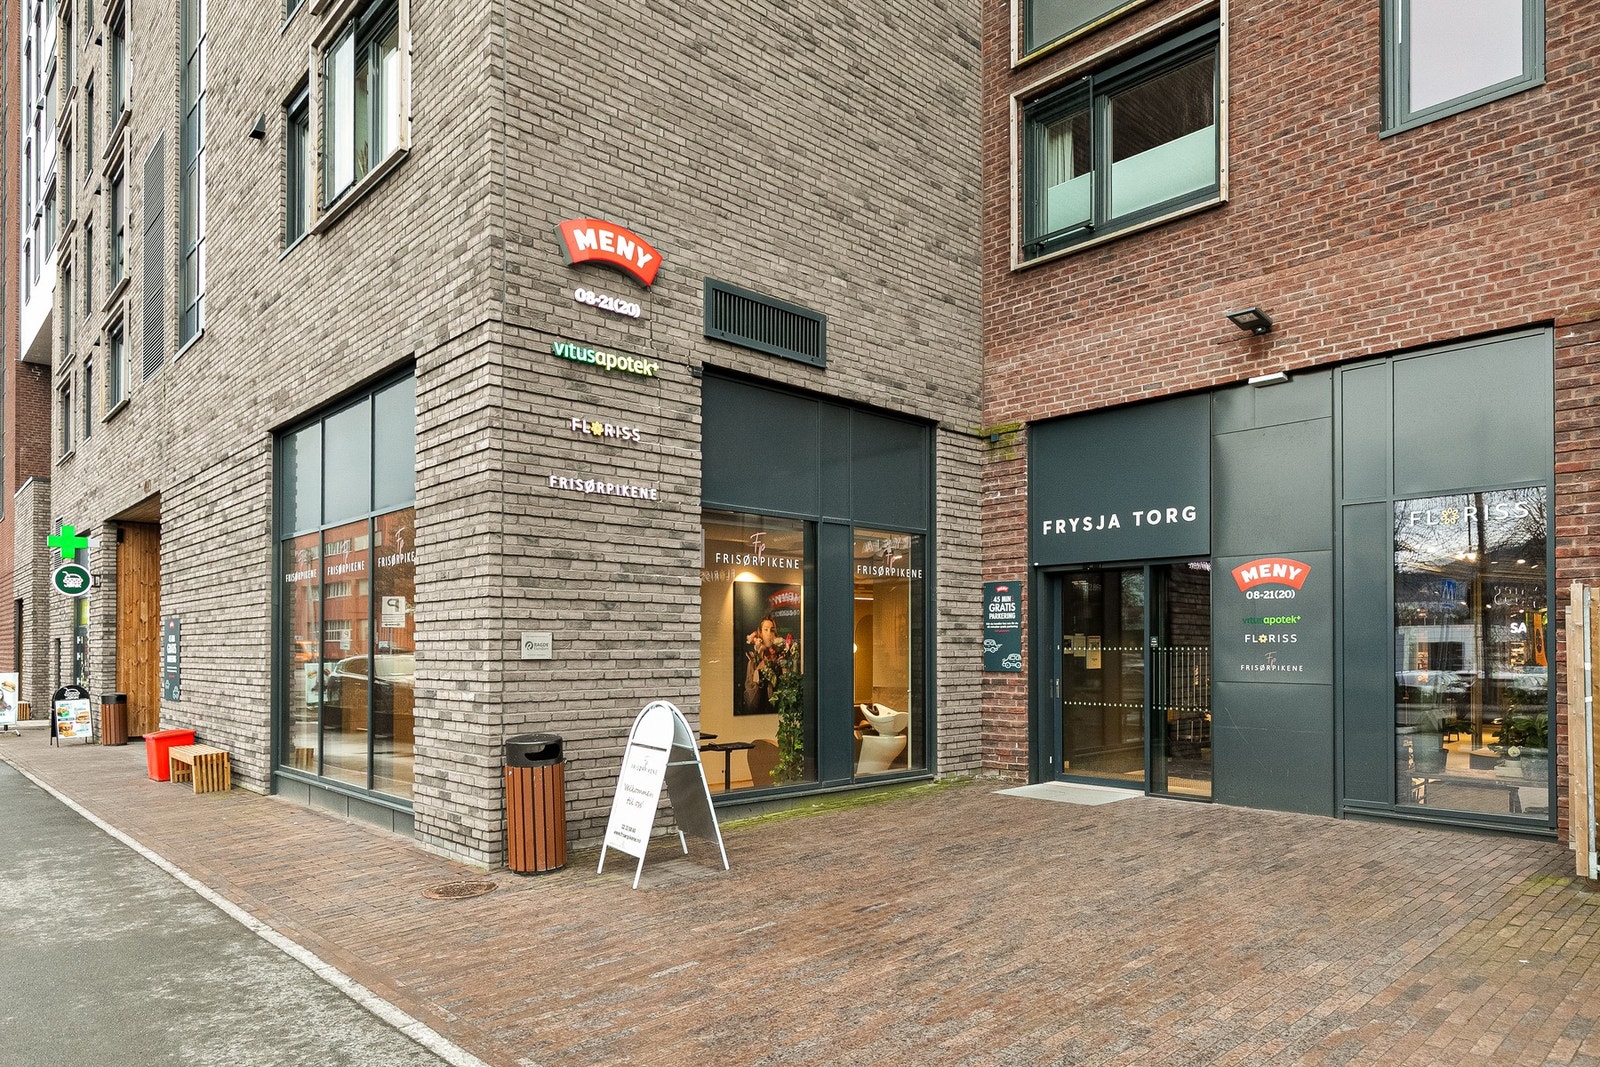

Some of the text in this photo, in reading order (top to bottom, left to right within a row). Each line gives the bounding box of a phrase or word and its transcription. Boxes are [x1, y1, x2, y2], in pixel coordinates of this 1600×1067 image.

[572, 228, 653, 270] MENY
[574, 287, 641, 319] 08-21(20)
[571, 417, 641, 443] FLORISS
[550, 475, 658, 501] FRISØRPIKENE
[1042, 505, 1198, 535] FRYSJA TORG
[715, 552, 800, 570] FRISØRPIKENE
[856, 564, 923, 579] FRISØRPIKENE
[1240, 563, 1303, 584] MENY
[1245, 589, 1296, 600] 08-21(20)
[988, 602, 1016, 612] GRATIS
[988, 612, 1016, 620] PARKERING
[1244, 634, 1298, 643] FLORISS
[1240, 664, 1304, 672] FRISØRPIKENE
